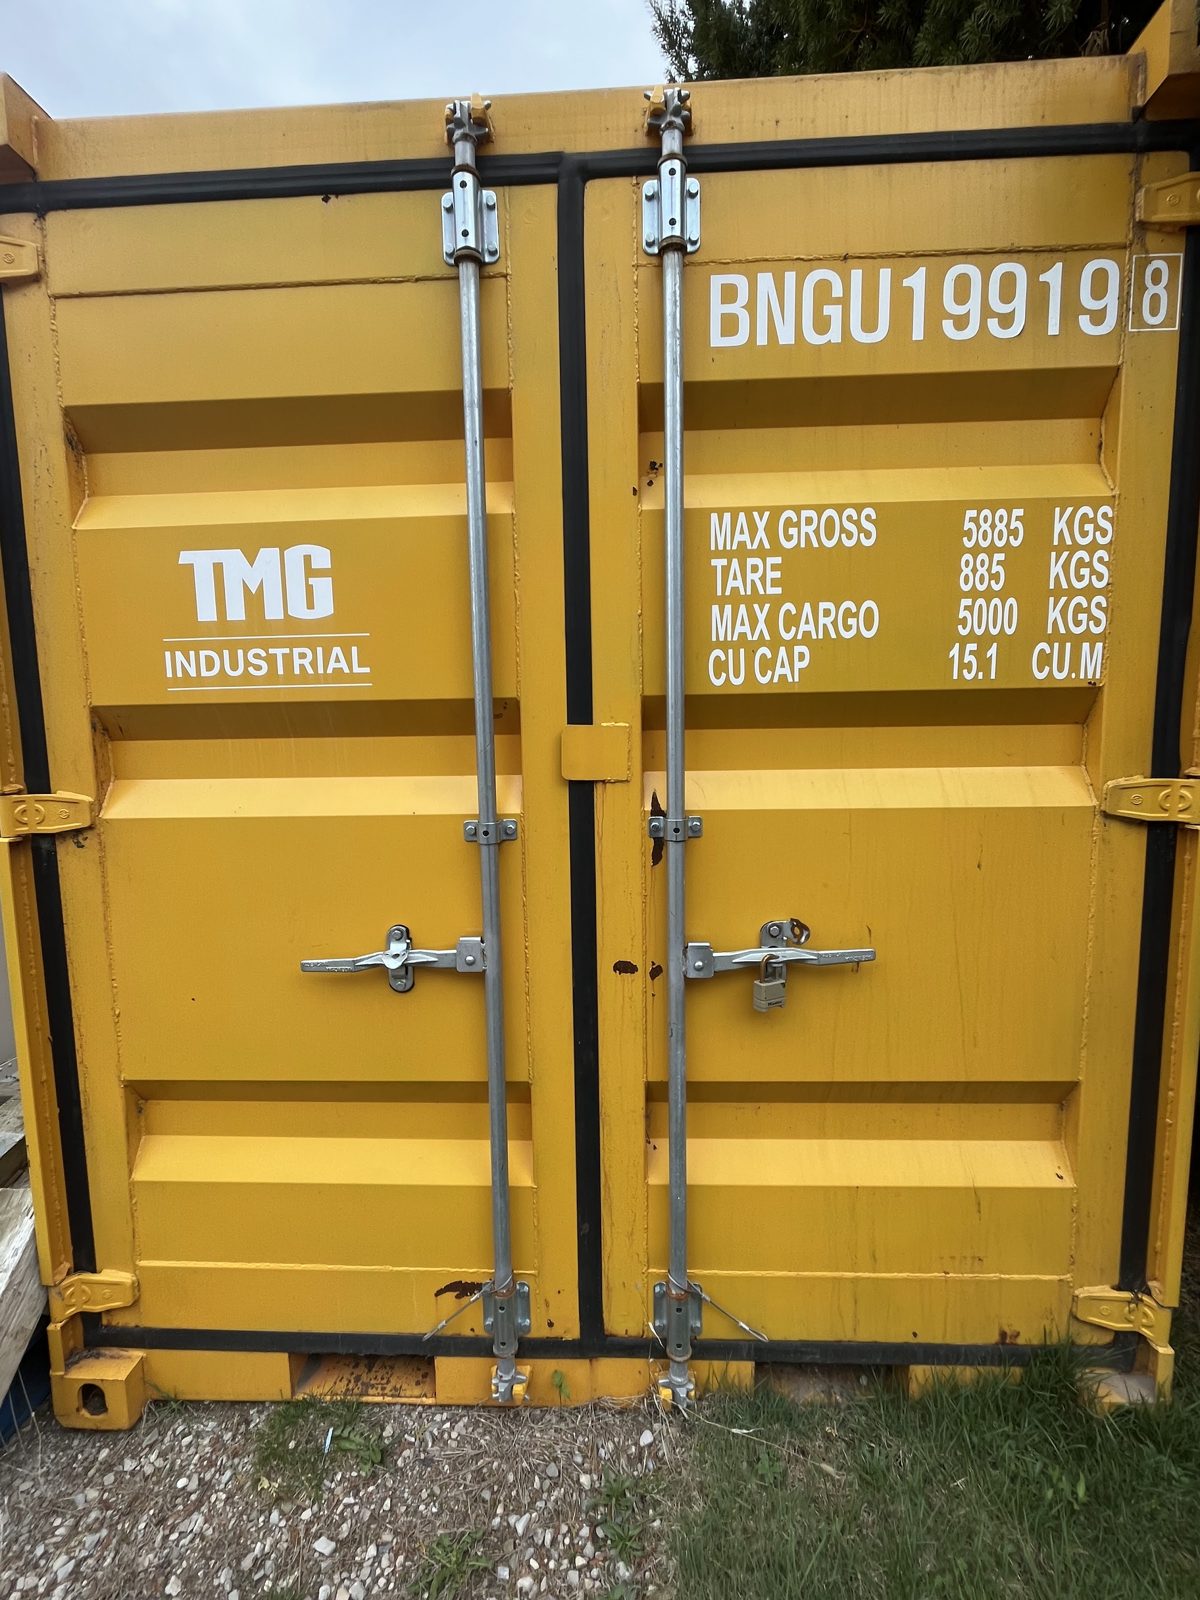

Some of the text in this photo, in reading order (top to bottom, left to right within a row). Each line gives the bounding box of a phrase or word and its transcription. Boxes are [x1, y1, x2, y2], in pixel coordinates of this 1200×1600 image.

[1143, 260, 1168, 325] 8
[711, 506, 1112, 550] MAX GROSS 5885 KGS
[178, 544, 334, 621] TMG
[711, 550, 1109, 596] TARE 885 KGS
[712, 596, 1106, 641] MAX CARGO 5000 KGS
[165, 646, 370, 677] INDUSTRIAL
[709, 642, 1103, 686] CU CAP 15.1 CU.M
